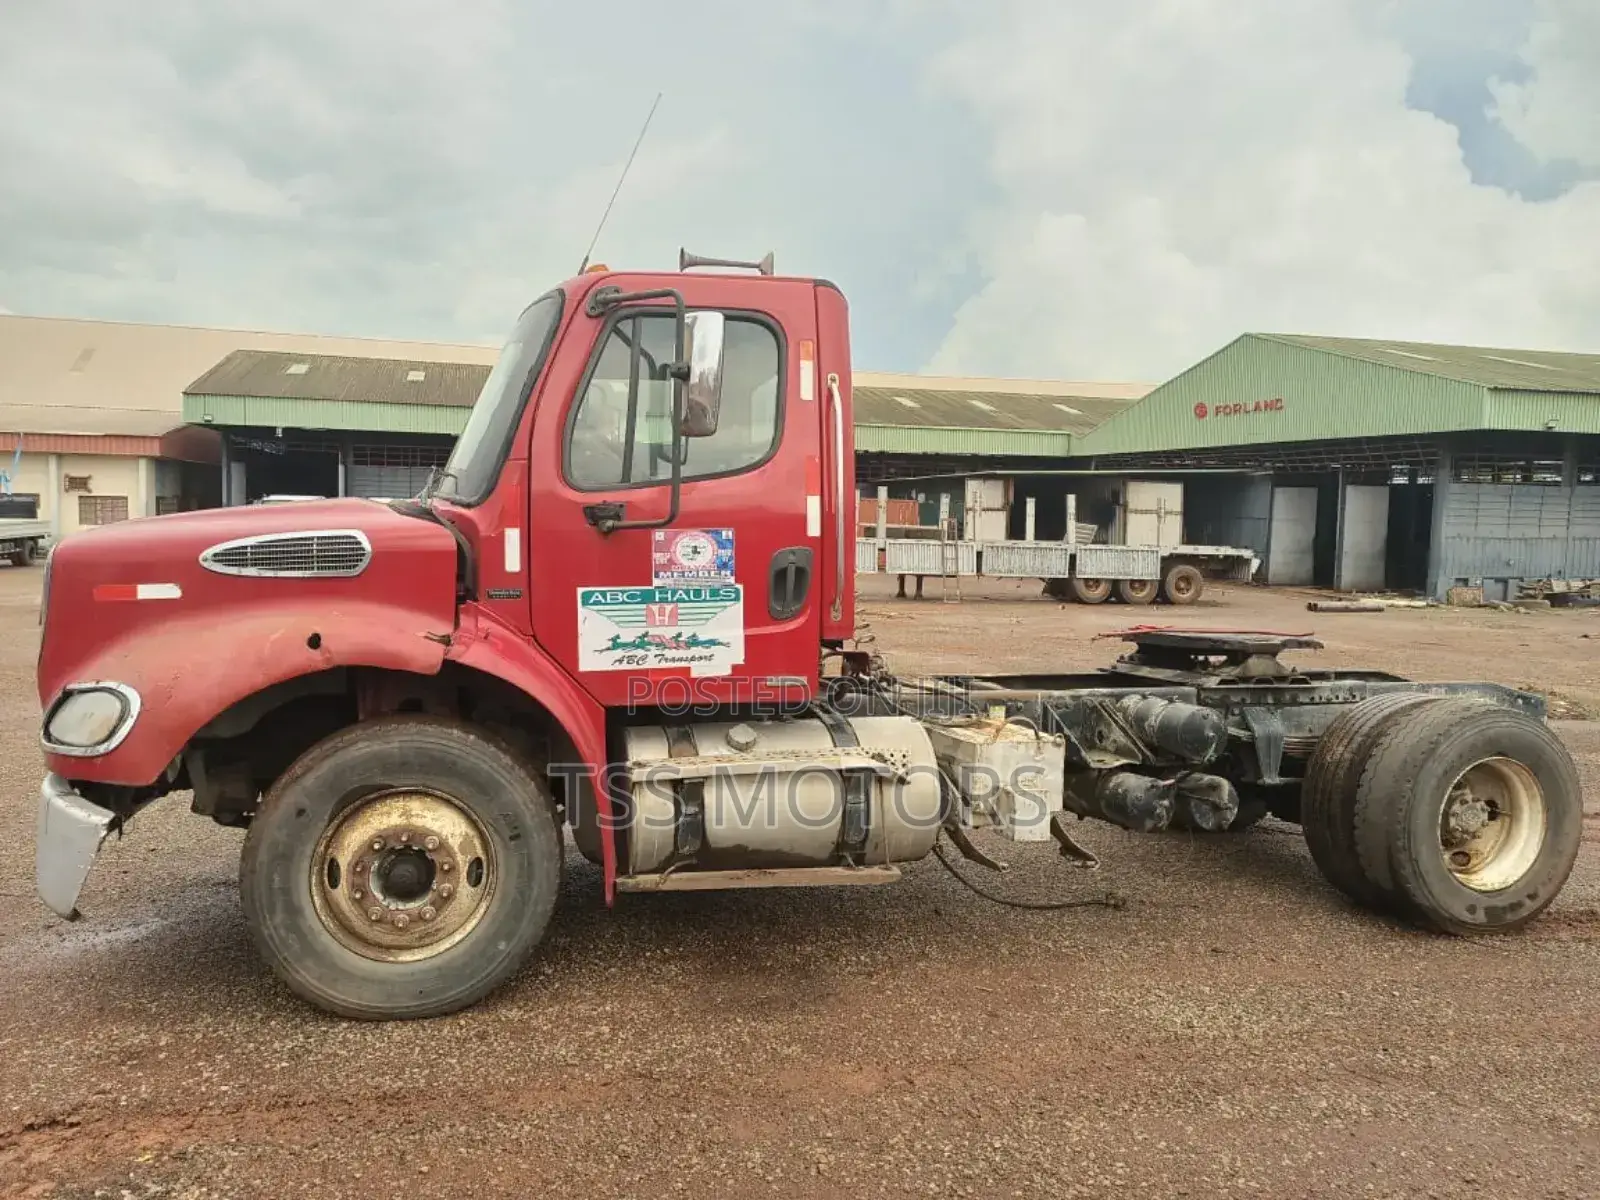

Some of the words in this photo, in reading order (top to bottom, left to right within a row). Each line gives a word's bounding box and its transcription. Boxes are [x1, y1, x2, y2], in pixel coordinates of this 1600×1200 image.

[588, 590, 642, 604] ABC
[654, 588, 737, 603] HAULS
[610, 654, 649, 665] ABC
[654, 653, 715, 664] Transport
